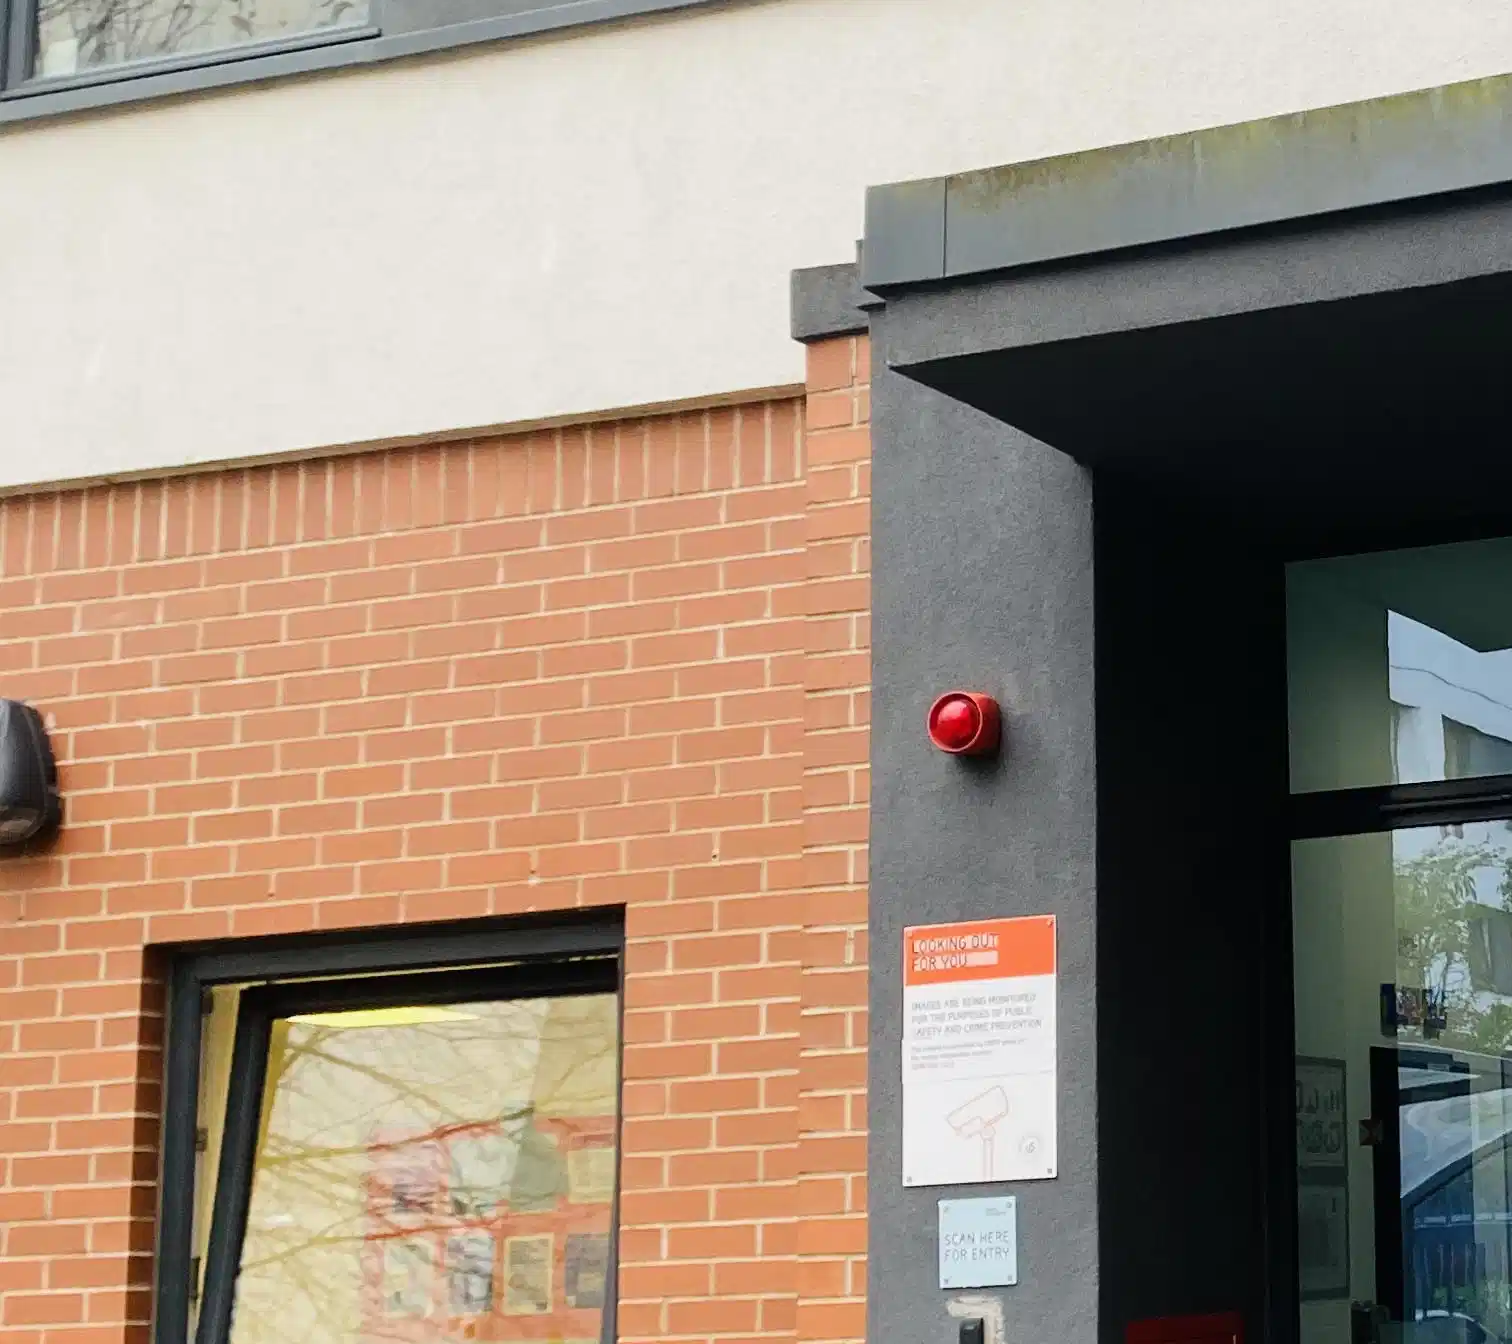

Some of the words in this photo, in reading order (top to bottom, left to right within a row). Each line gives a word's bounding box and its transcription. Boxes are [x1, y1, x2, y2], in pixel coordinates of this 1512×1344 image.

[911, 937, 967, 954] LOOKING
[971, 932, 1000, 948] OUT
[911, 957, 937, 973] FOR
[940, 953, 968, 968] YOU
[944, 1231, 975, 1247] SCAN
[980, 1229, 1009, 1244] HERE
[944, 1247, 968, 1263] FOR
[971, 1246, 1009, 1261] ENTRY
